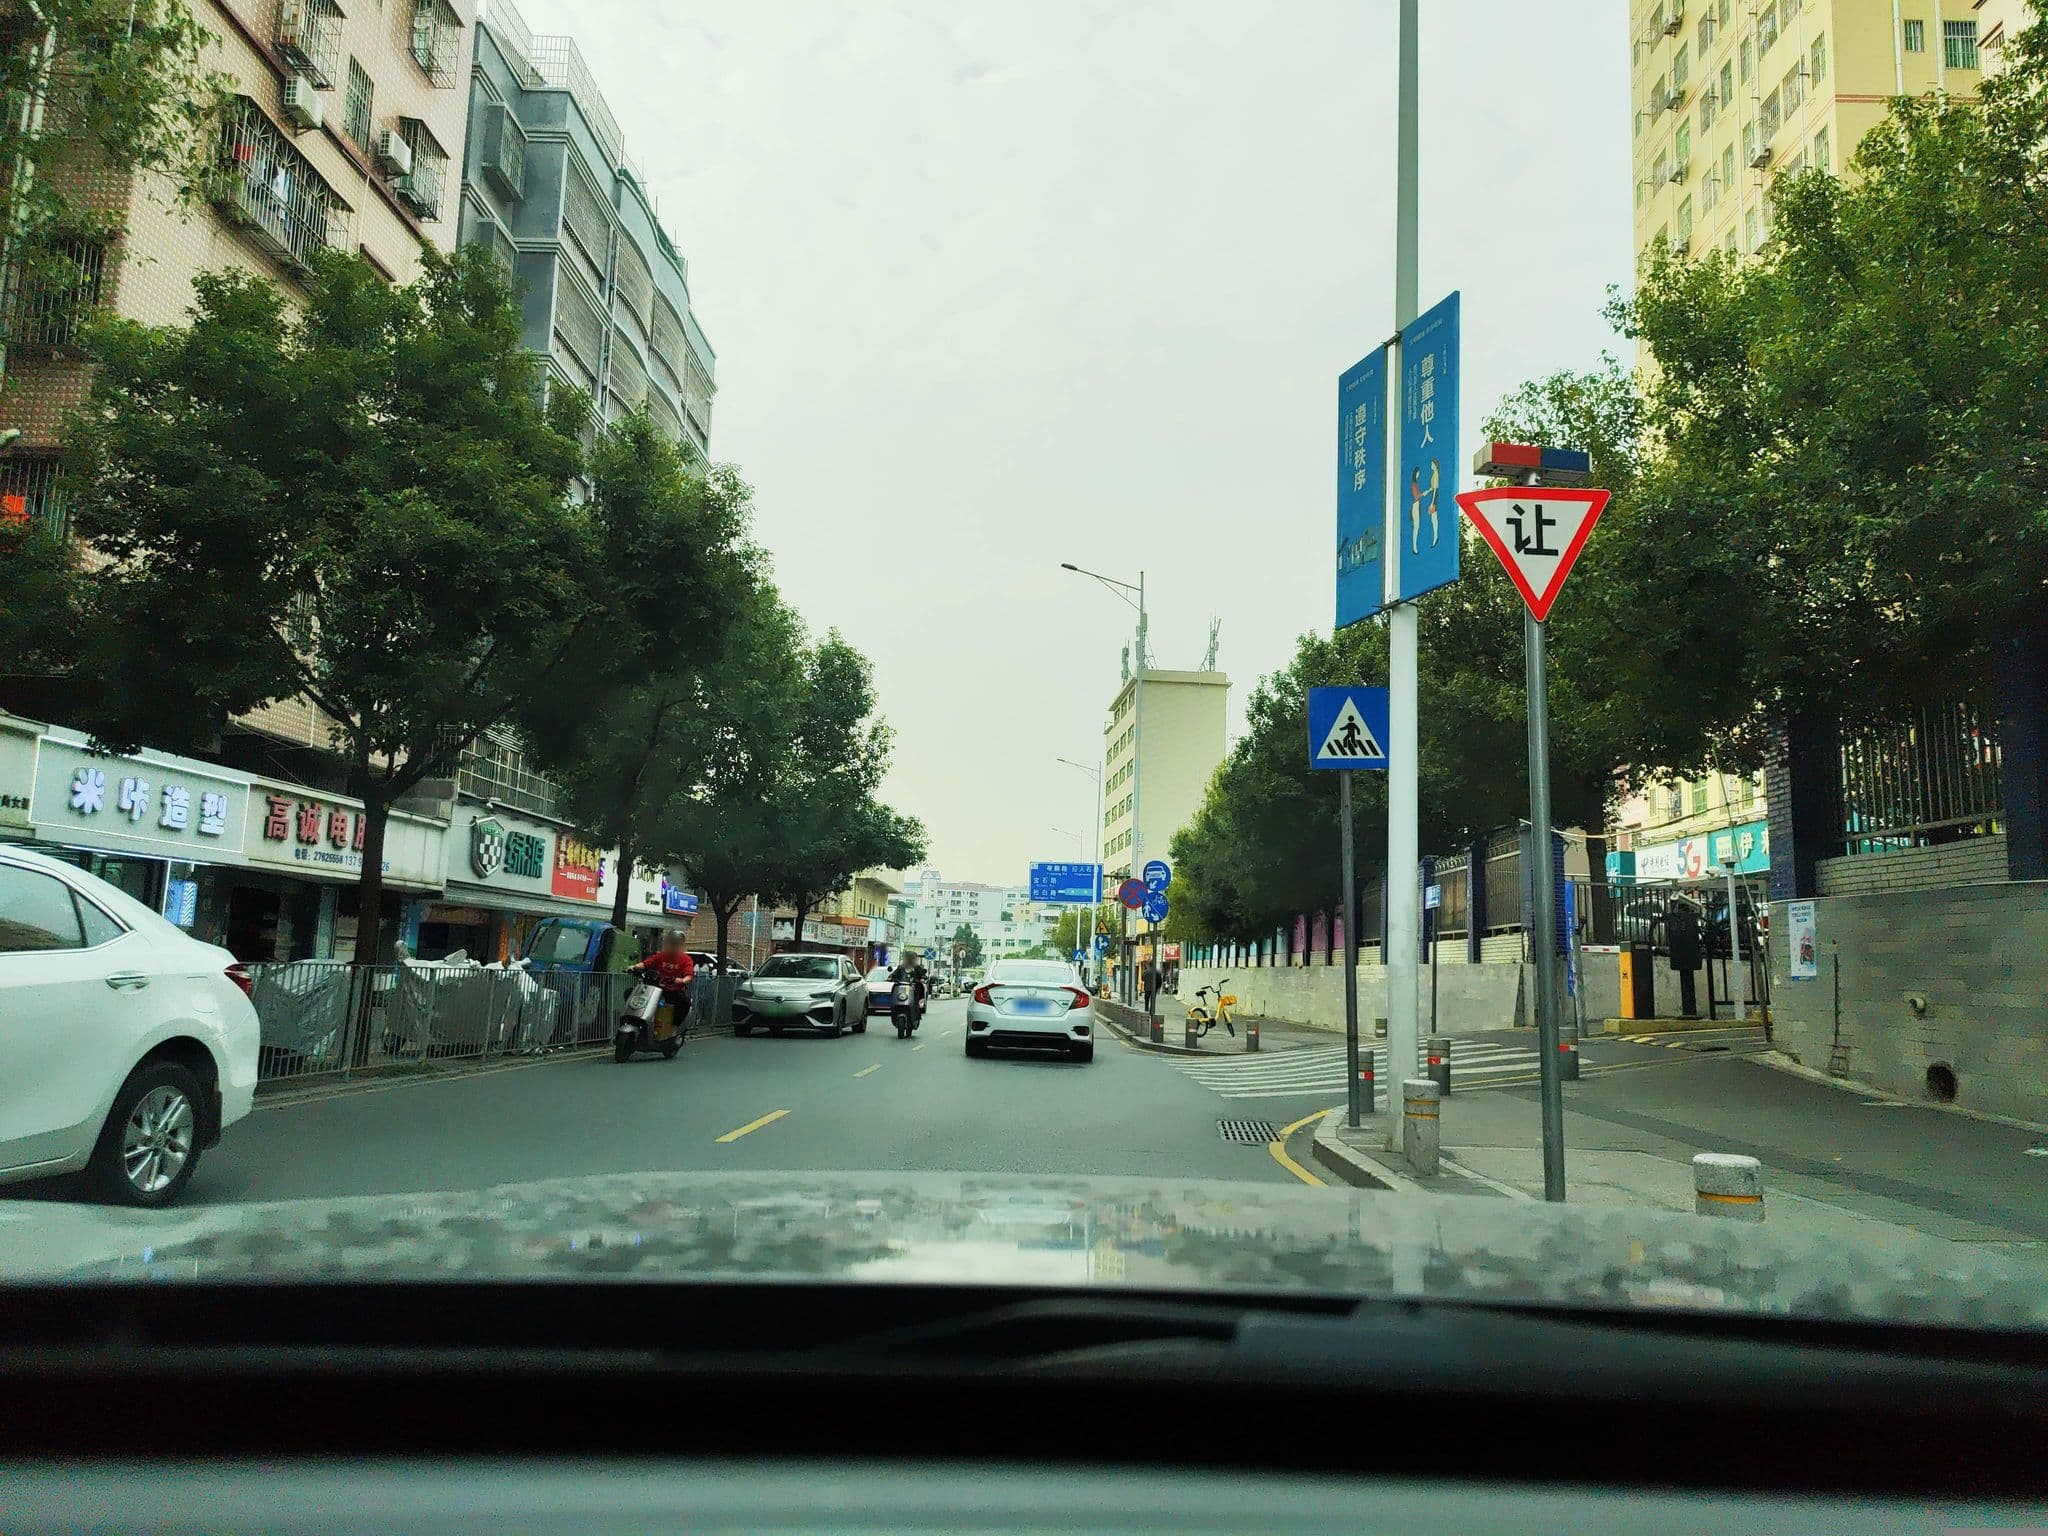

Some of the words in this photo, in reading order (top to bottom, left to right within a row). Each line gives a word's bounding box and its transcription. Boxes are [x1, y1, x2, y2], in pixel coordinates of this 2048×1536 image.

[1420, 353, 1435, 448] 尊重他人
[1354, 402, 1367, 492] 遵守秩序
[1506, 503, 1559, 556] 让
[70, 766, 229, 836] 米咔造型
[1676, 838, 1700, 879] 5G
